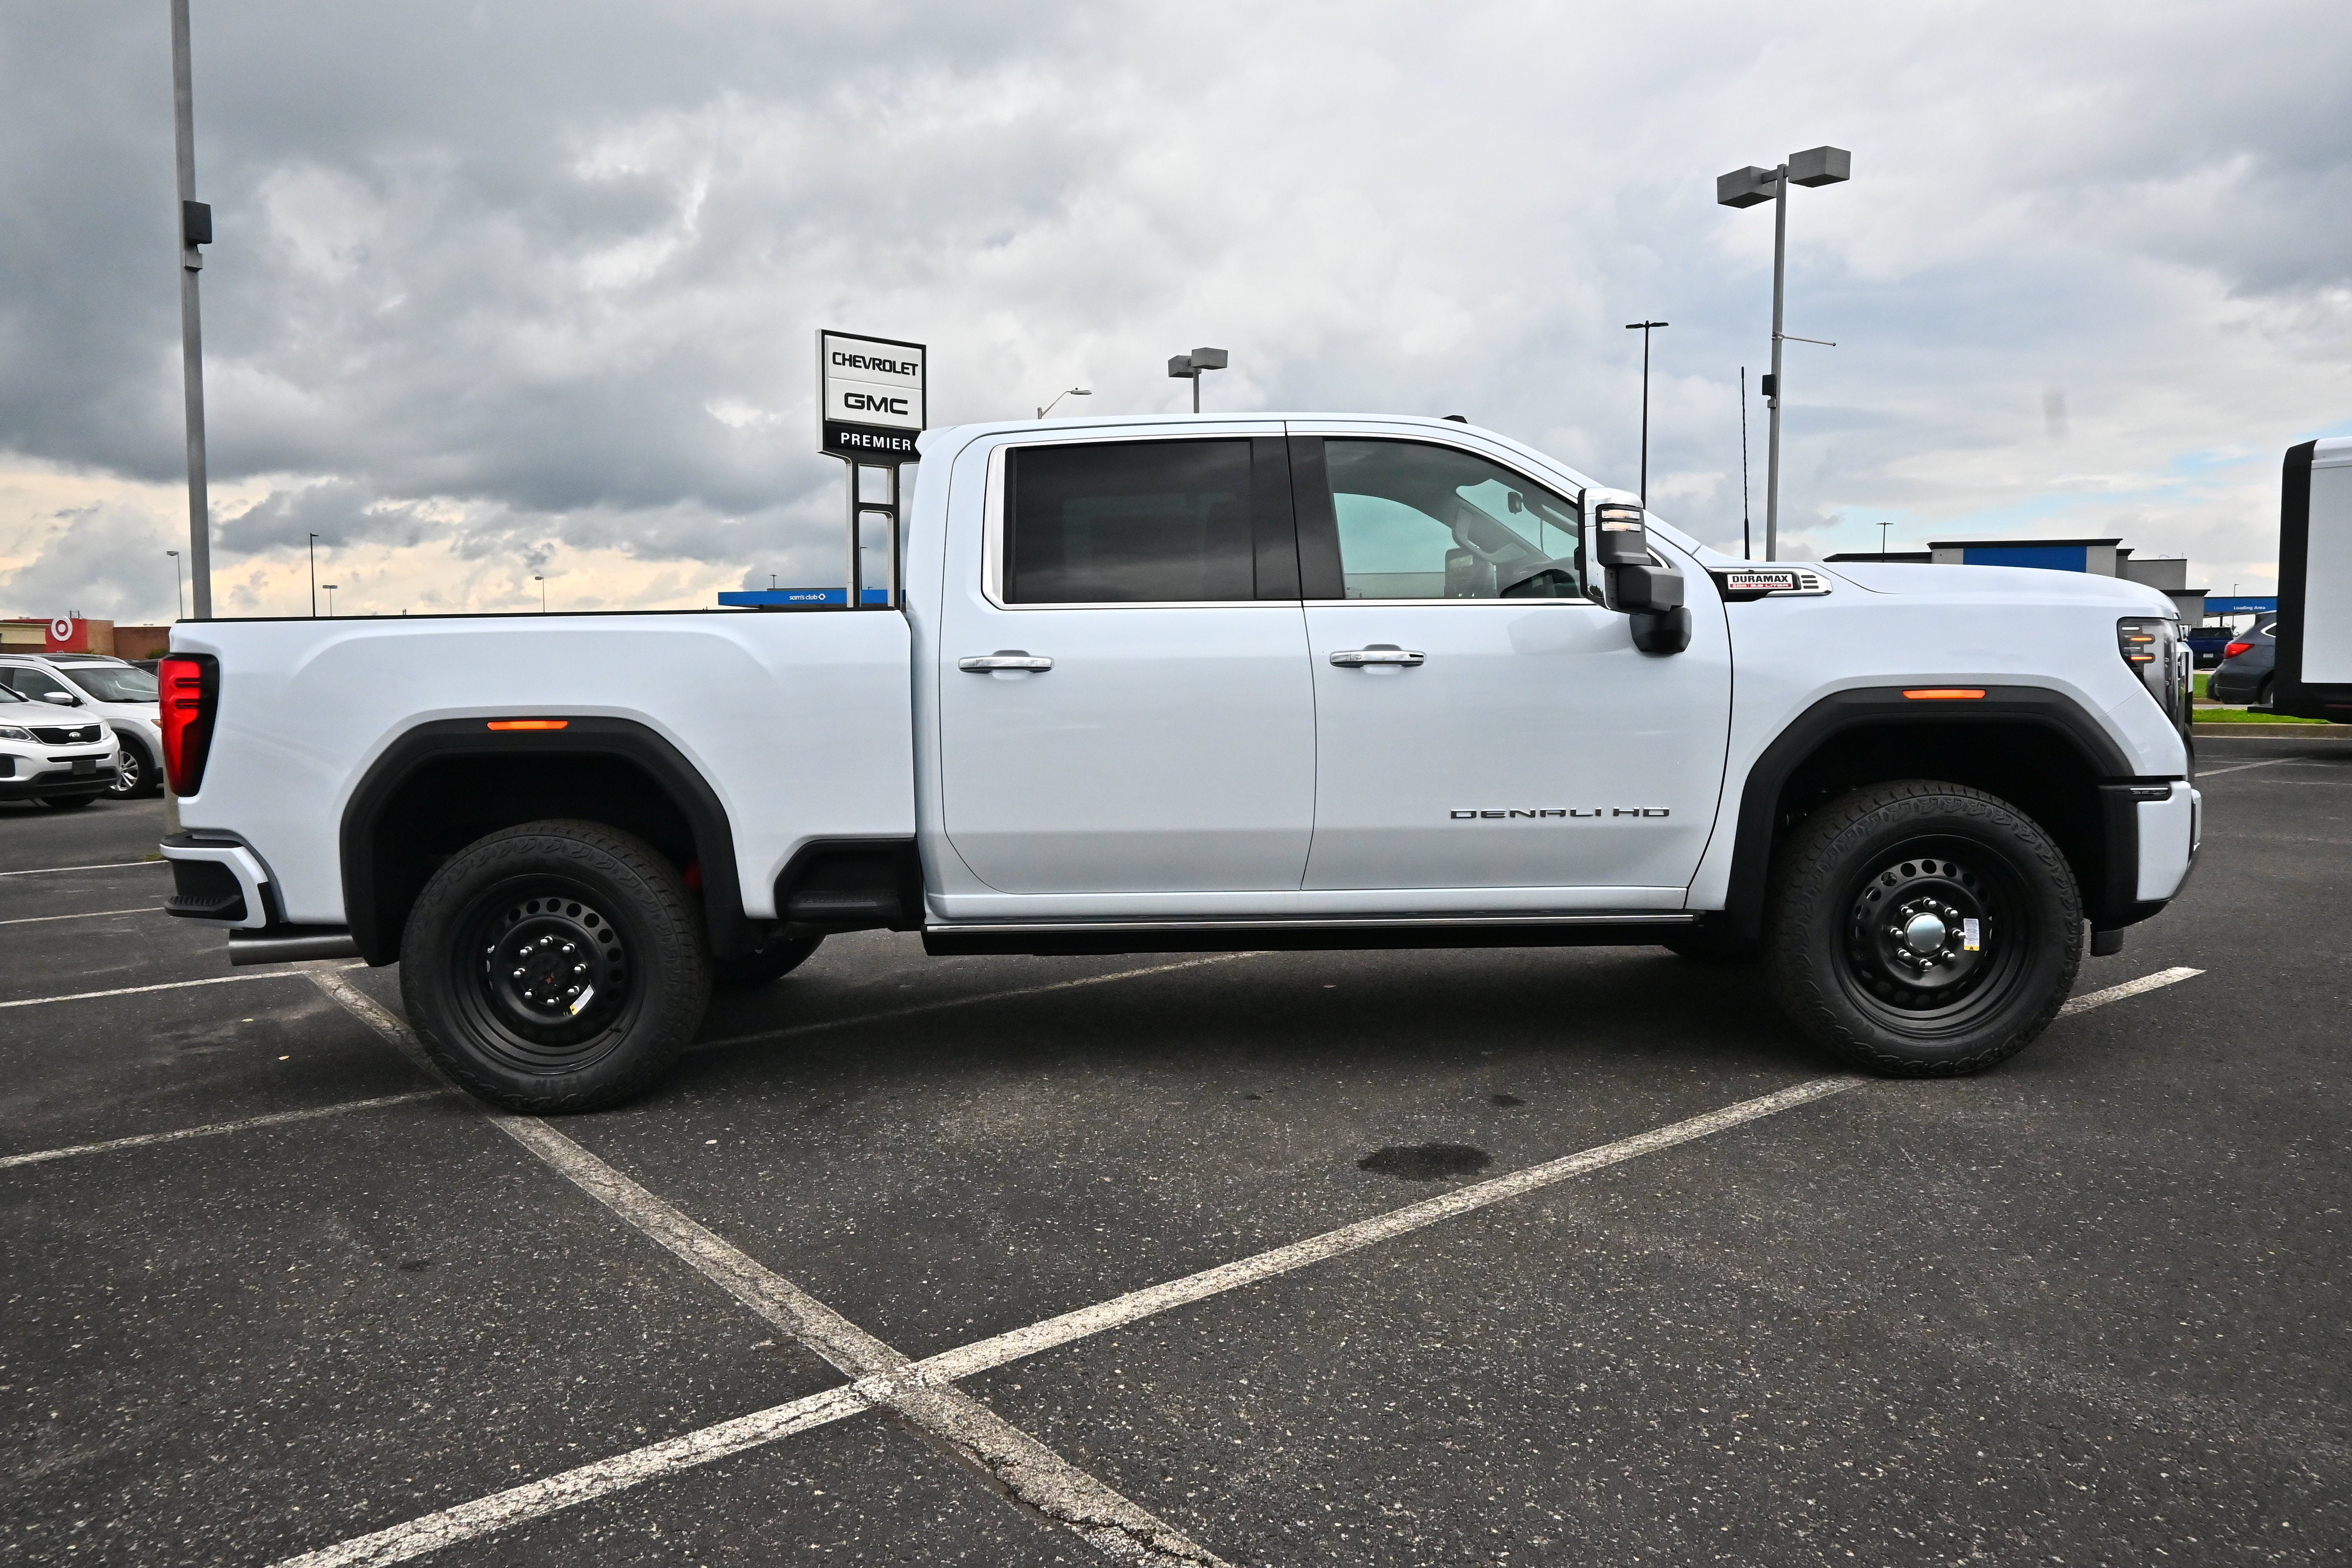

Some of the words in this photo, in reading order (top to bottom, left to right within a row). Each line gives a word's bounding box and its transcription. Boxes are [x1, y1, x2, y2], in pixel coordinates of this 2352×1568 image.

[832, 351, 918, 376] CHEVROLET
[844, 392, 908, 415] GMC
[841, 432, 911, 451] PREMIER
[1450, 806, 1602, 819] DENALI
[1613, 806, 1670, 817] HD
